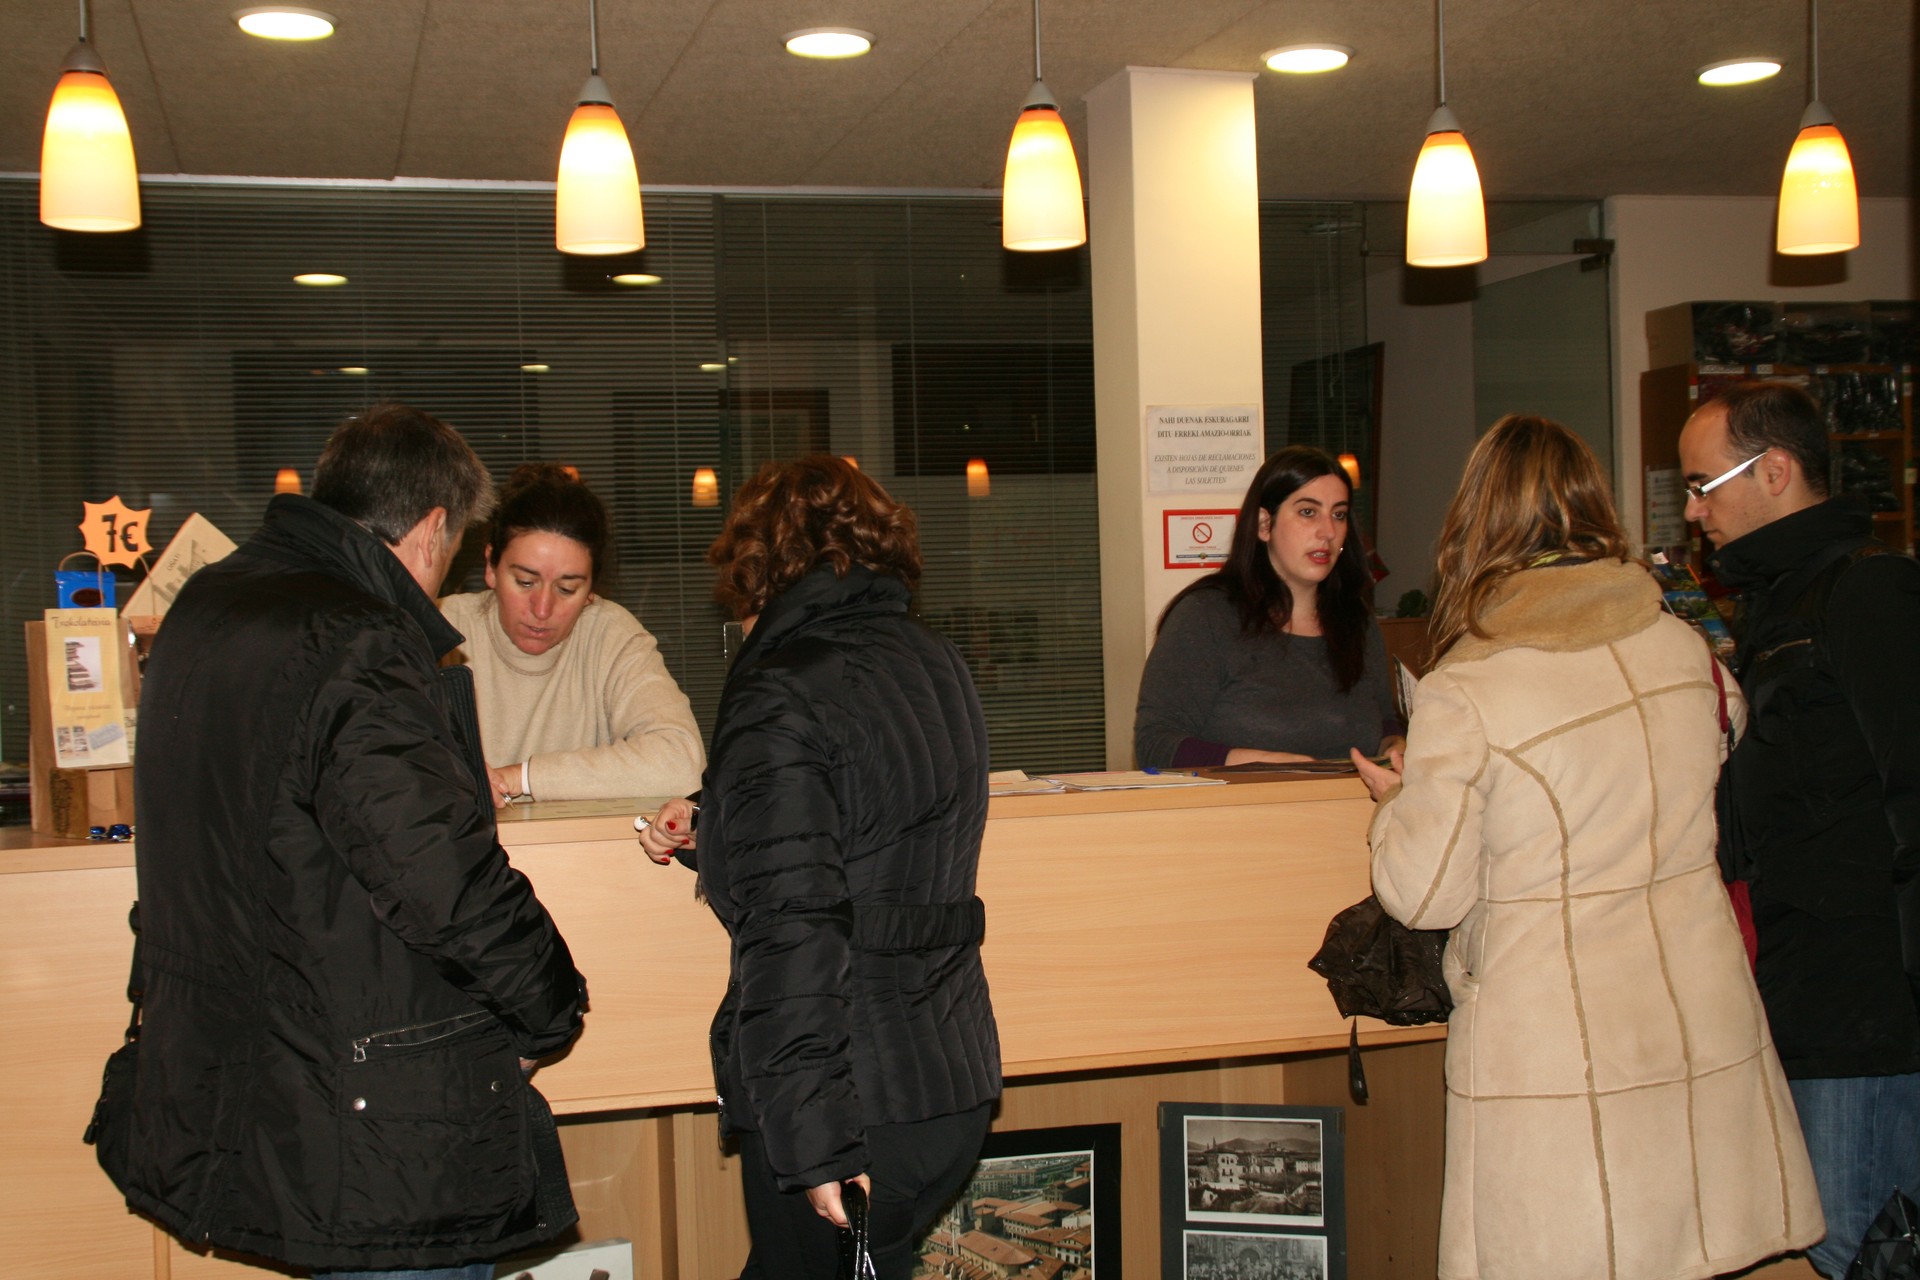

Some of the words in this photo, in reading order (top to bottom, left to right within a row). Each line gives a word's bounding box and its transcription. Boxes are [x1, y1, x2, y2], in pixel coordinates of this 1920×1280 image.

[1176, 416, 1203, 424] DUENAK
[1204, 415, 1250, 423] ESKURAGARRI
[1157, 430, 1172, 438] DITU
[1174, 429, 1252, 438] ERREKLAMAZIO-ORRIAK
[1154, 454, 1178, 462] EXISTEN
[1207, 452, 1256, 460] RECLAMACIONES
[1209, 465, 1219, 473] DE
[1219, 464, 1245, 474] QUIENES
[1197, 476, 1227, 484] SOLICITEN
[101, 513, 139, 553] 7€
